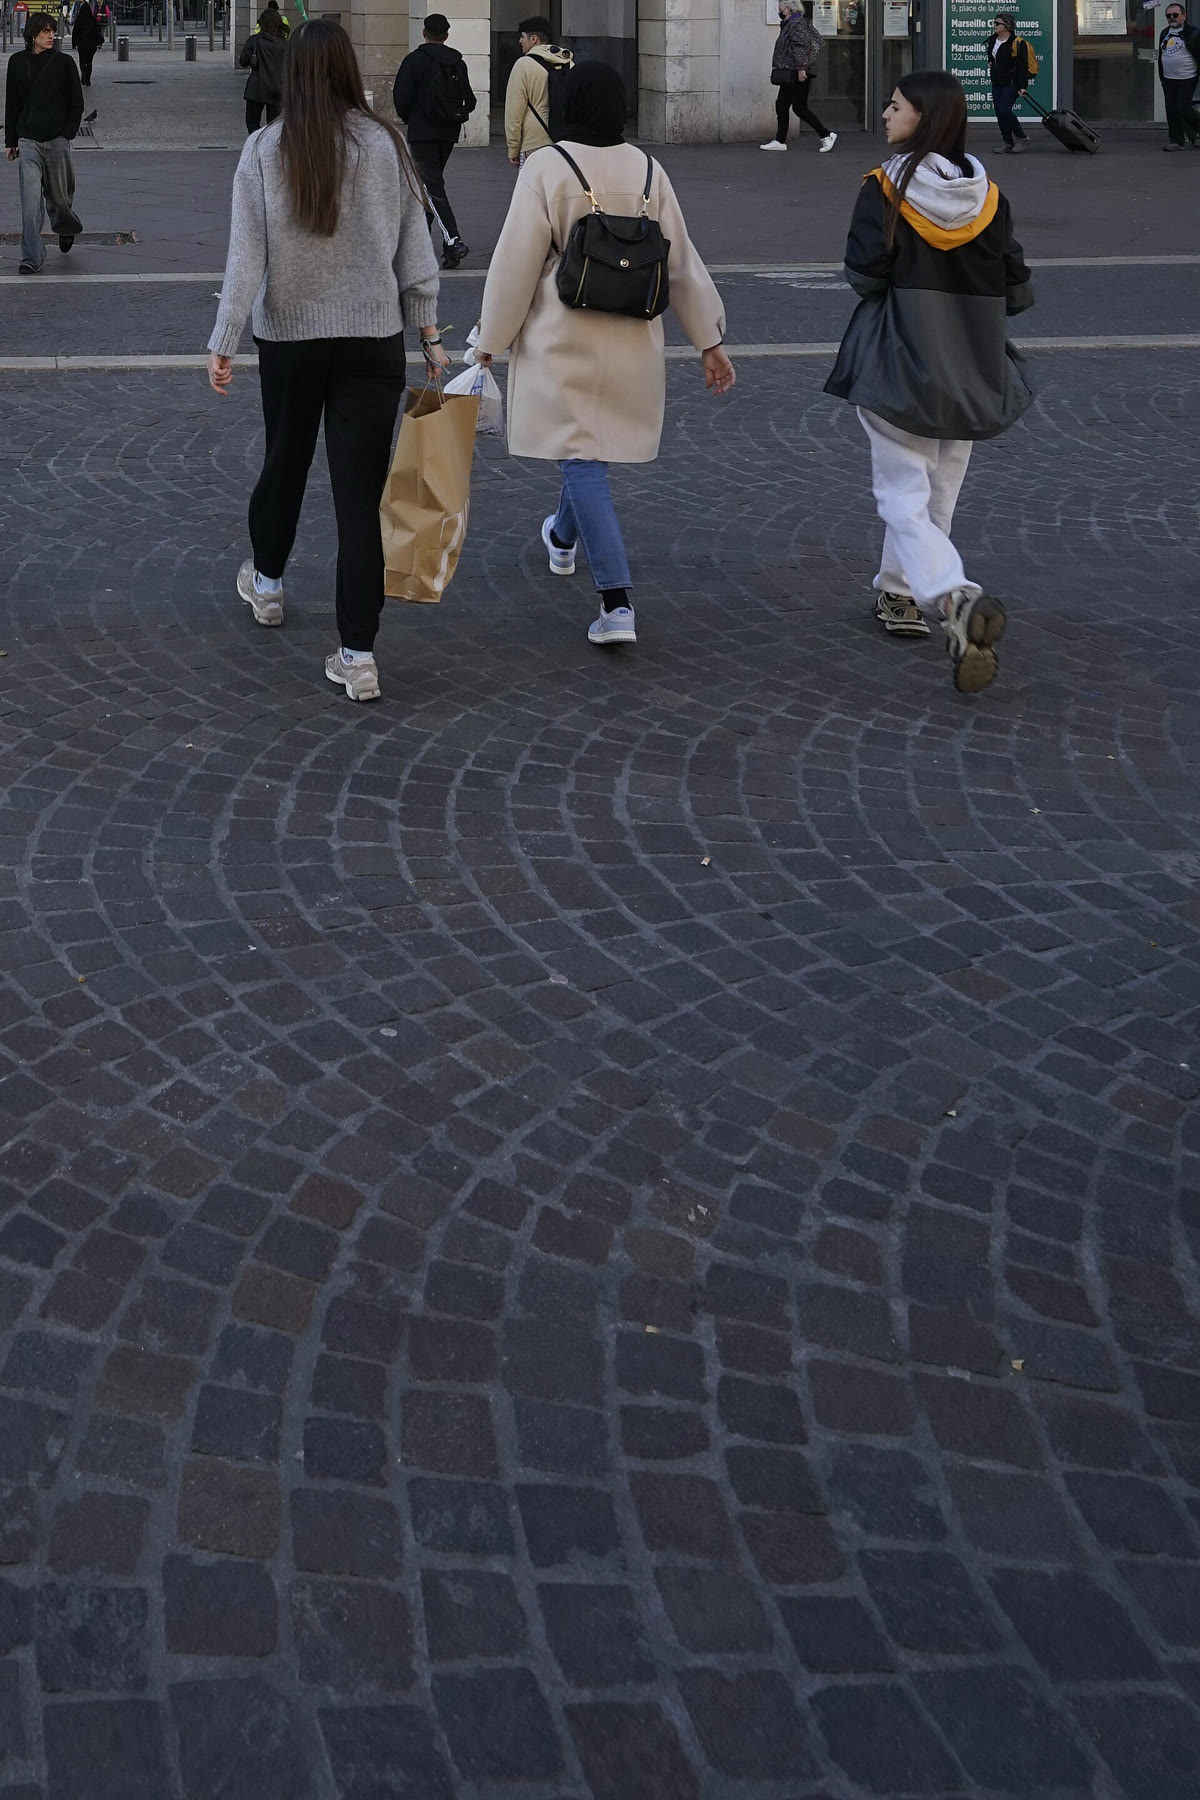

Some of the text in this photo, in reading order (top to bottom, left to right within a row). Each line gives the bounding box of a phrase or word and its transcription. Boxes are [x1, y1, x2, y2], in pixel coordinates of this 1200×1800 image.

[952, 19, 986, 27] Marseille
[952, 44, 986, 52] Marseille
[952, 53, 963, 61] 122,
[952, 68, 986, 76] Marseille
[965, 93, 986, 101] seille
[967, 102, 980, 110] lage
